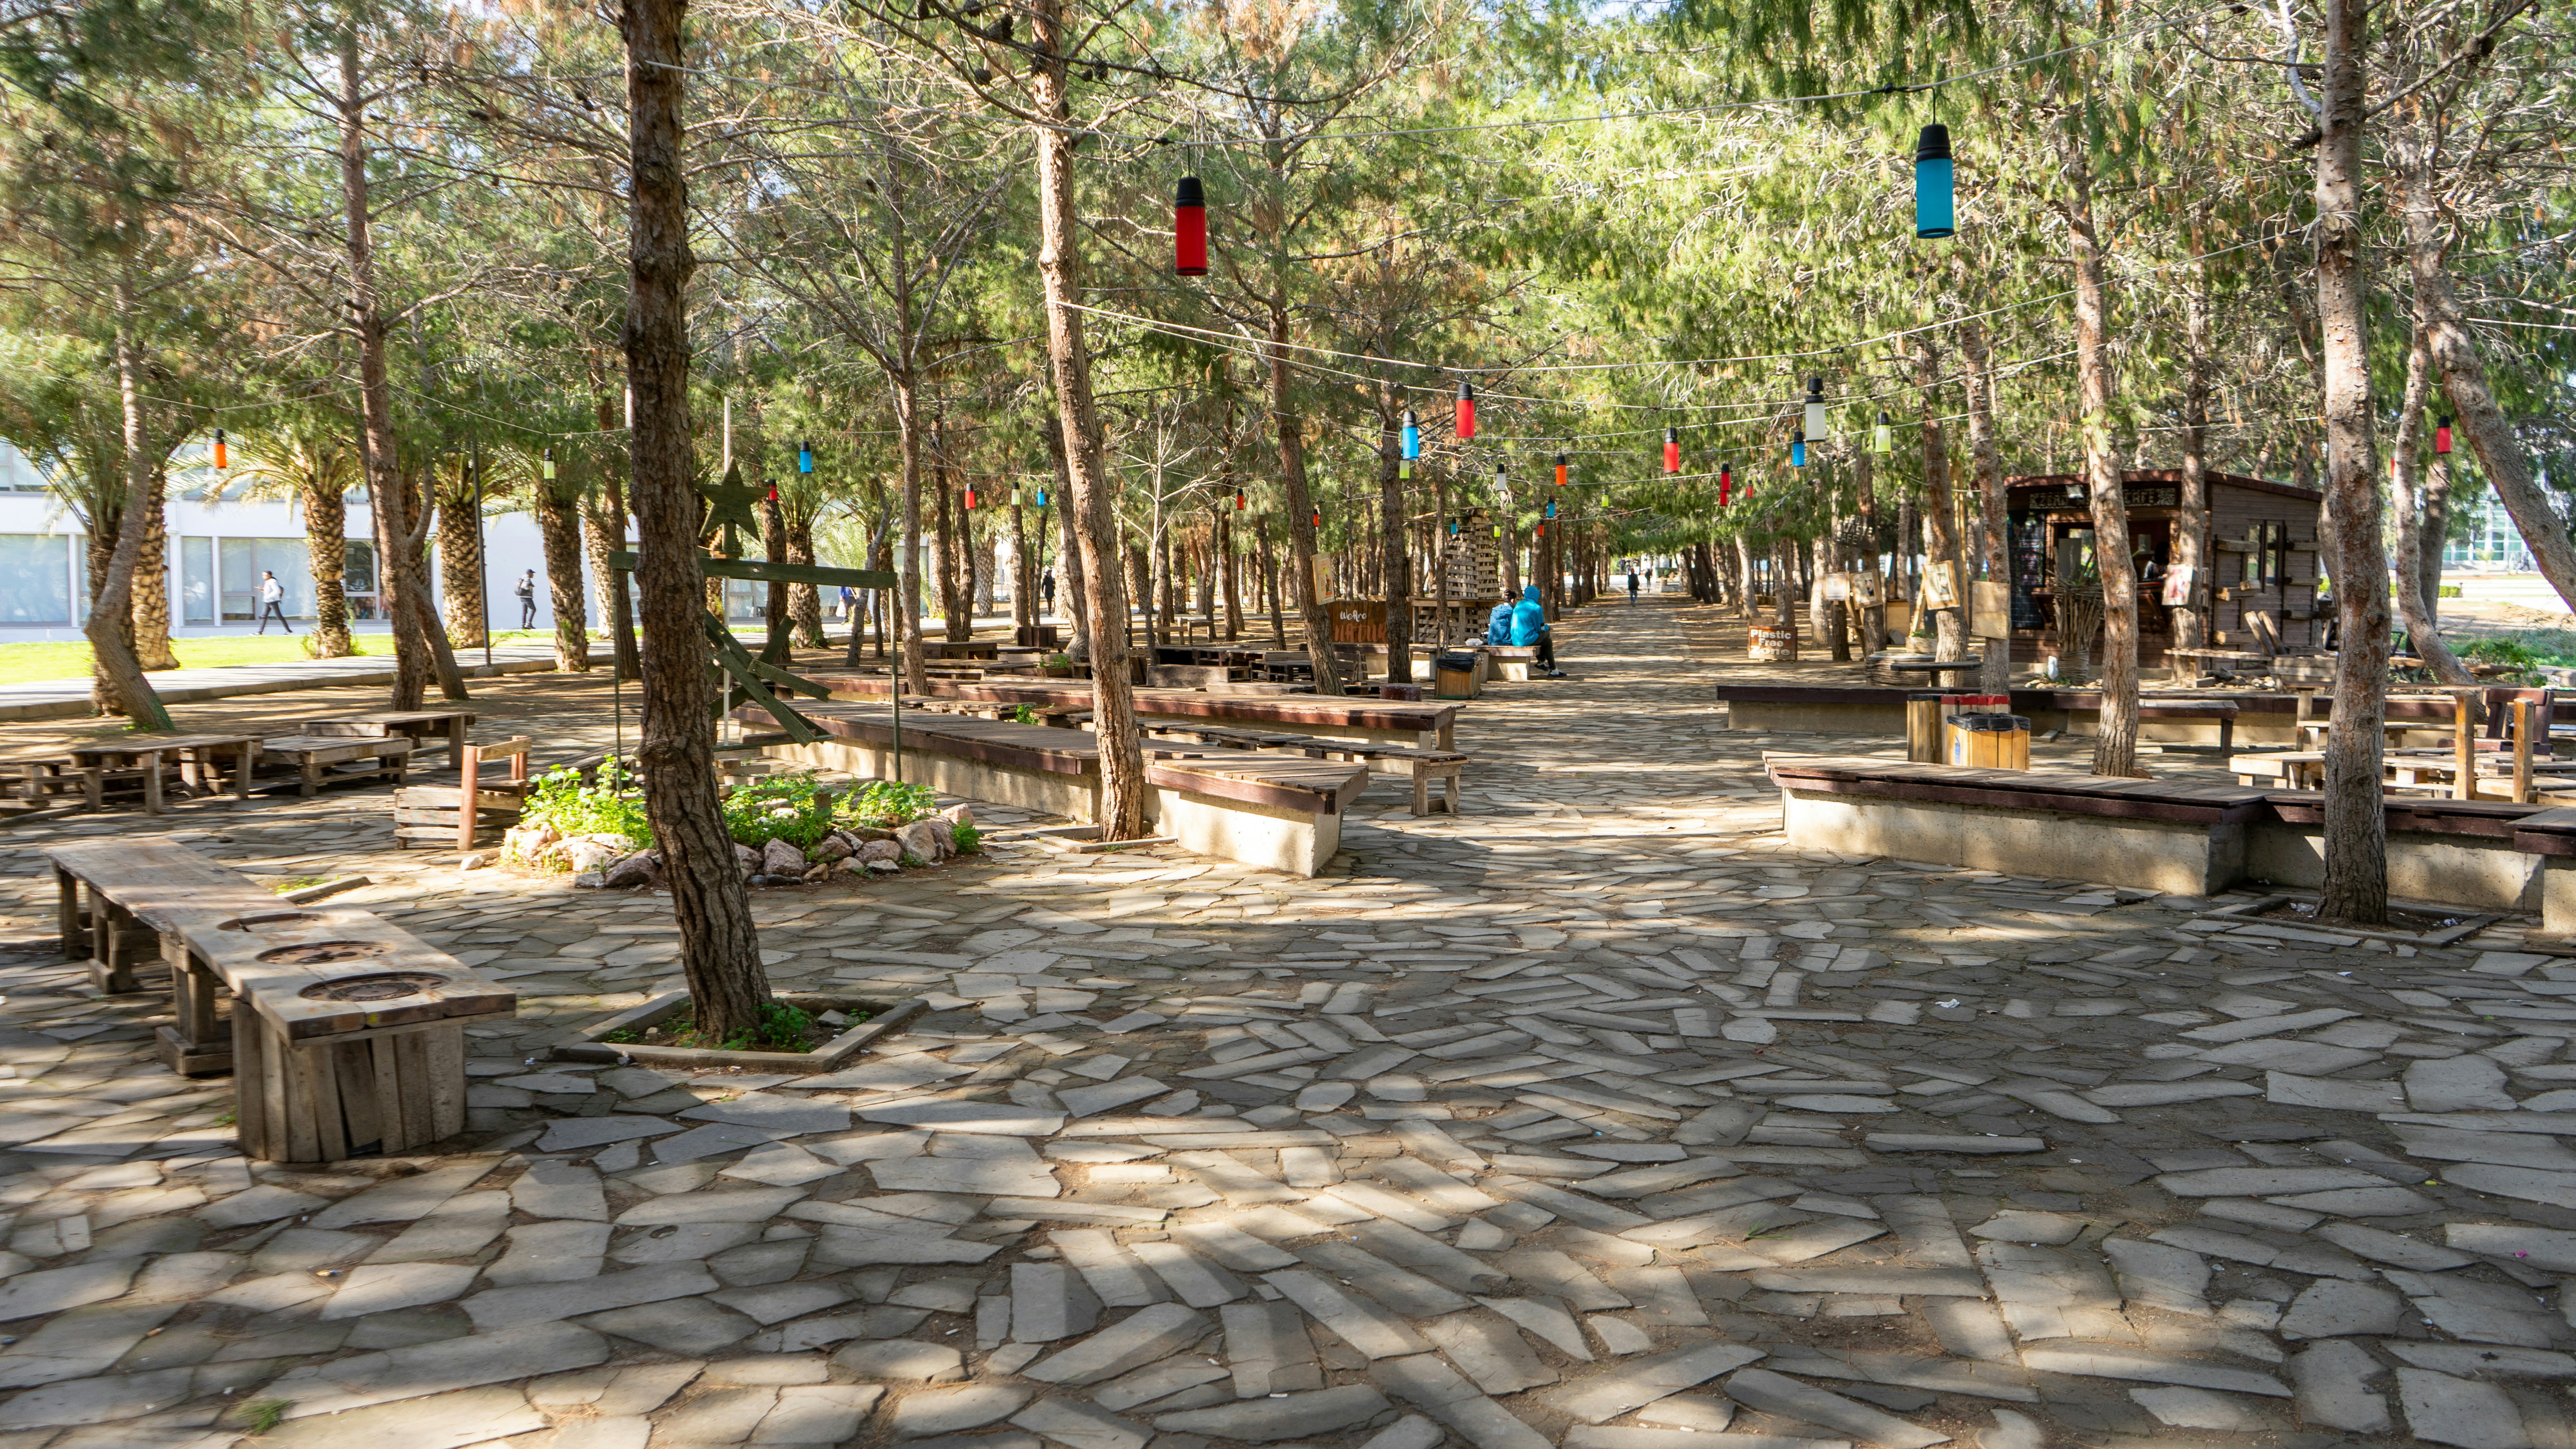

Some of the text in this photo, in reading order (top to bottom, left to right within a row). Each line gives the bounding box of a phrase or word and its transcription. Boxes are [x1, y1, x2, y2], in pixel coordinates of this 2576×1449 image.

[2124, 492, 2155, 504] CAFE
[1750, 629, 1791, 639] Plastic
[1758, 638, 1784, 647] Free
[1750, 646, 1790, 655] Zone
